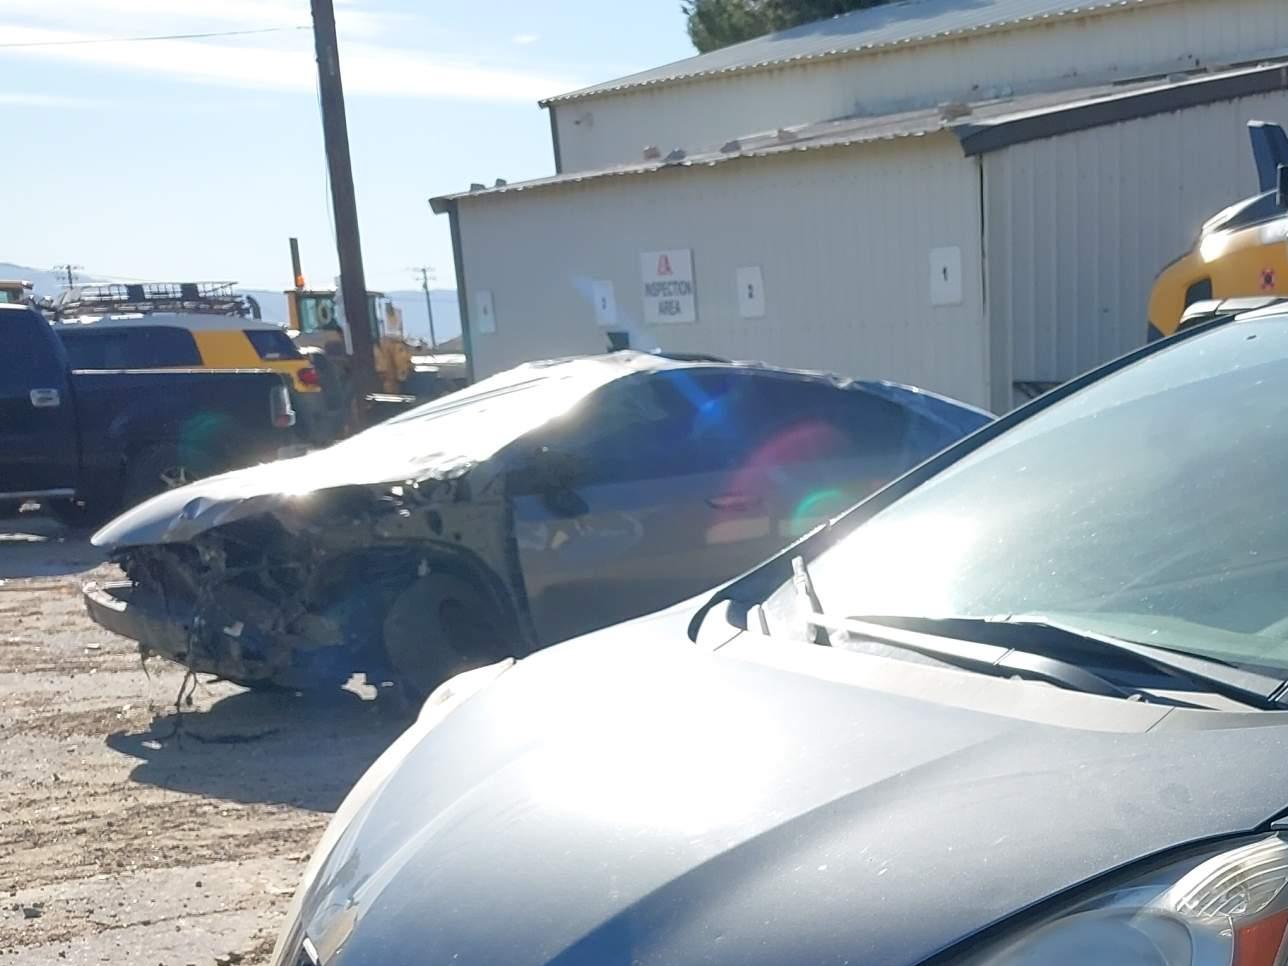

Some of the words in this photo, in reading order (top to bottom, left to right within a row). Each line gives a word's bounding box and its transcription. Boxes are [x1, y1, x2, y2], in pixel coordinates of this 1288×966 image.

[942, 265, 949, 282] 1
[645, 281, 692, 297] INSPECTION
[658, 299, 682, 316] AREA
